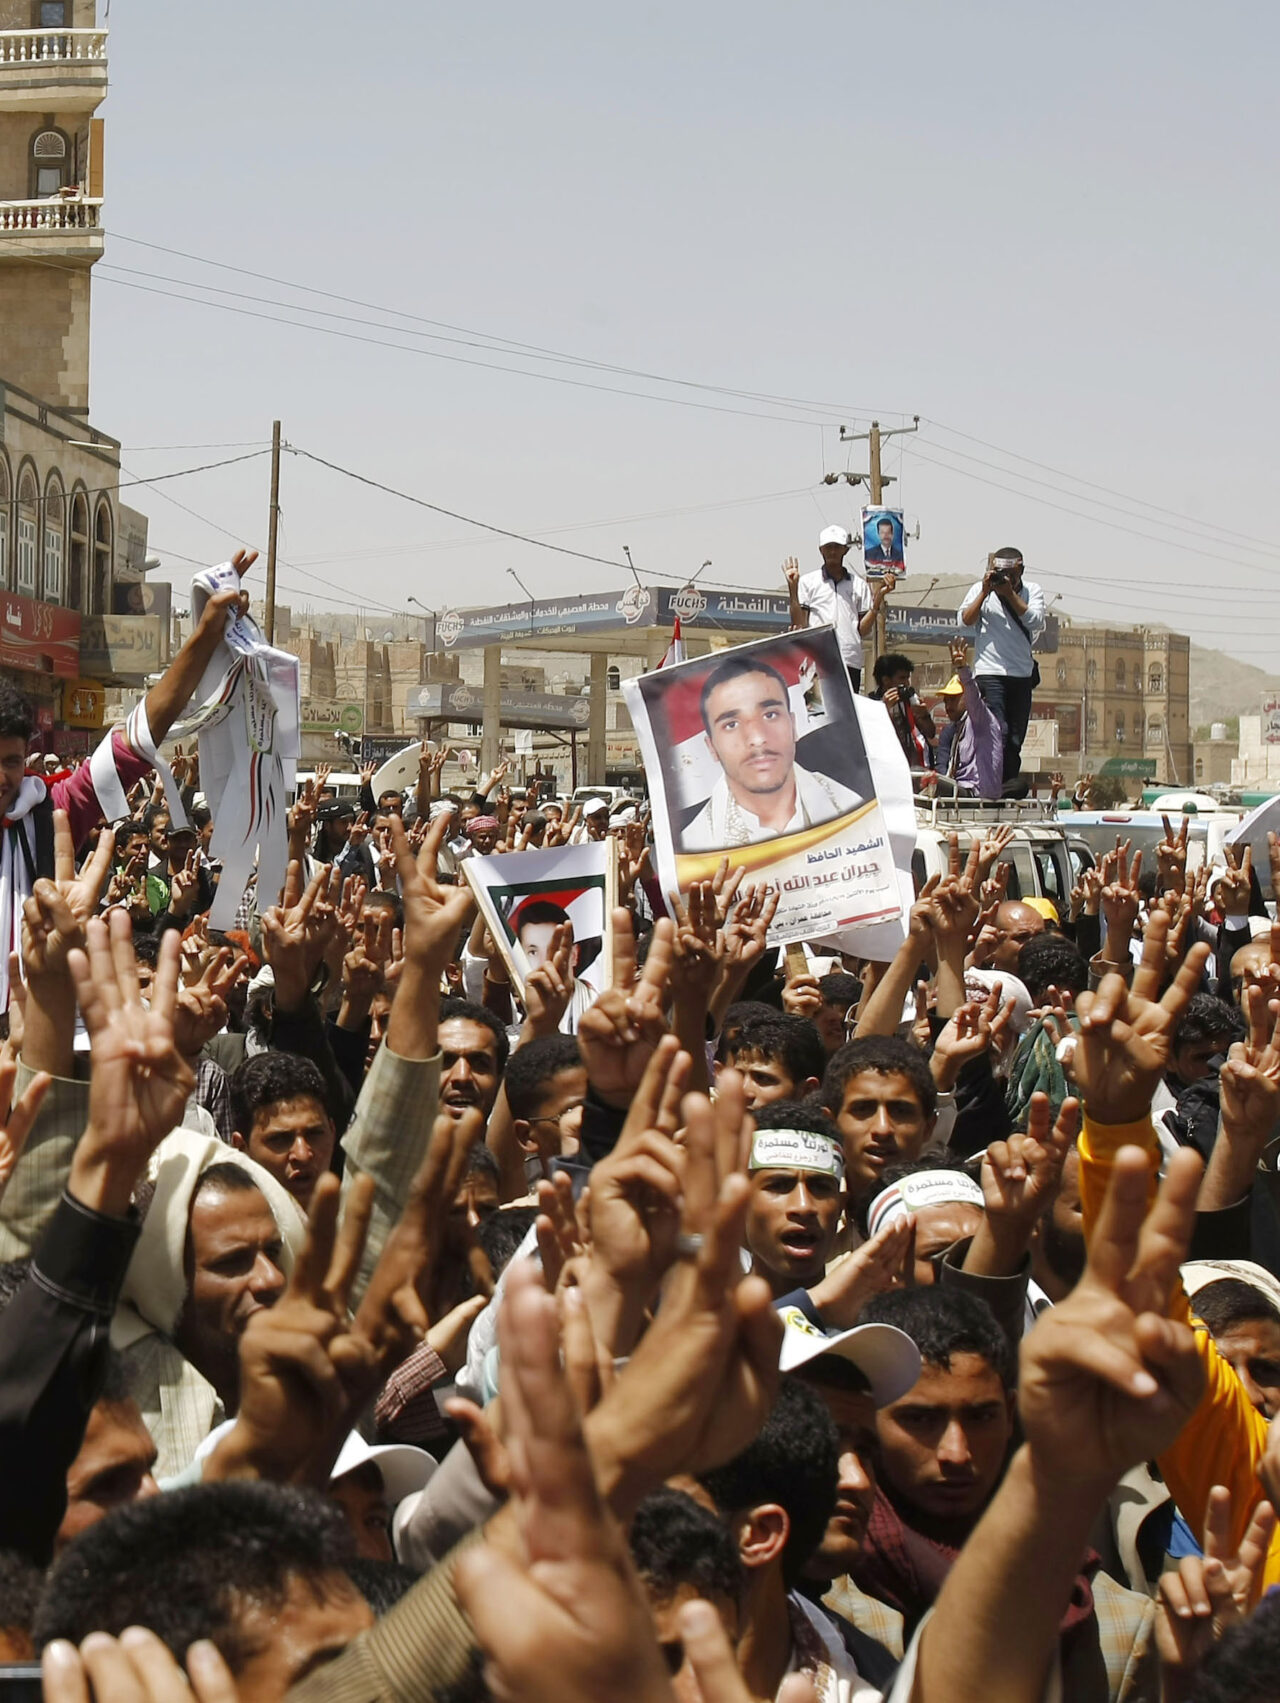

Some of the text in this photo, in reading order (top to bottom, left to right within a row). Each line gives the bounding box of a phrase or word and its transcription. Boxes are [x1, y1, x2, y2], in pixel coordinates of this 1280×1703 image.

[558, 603, 587, 616] العصيمي
[588, 602, 609, 612] محطة
[670, 596, 706, 609] FUCHS
[717, 596, 770, 615] النفطية
[531, 607, 557, 618] للخدمات
[436, 618, 464, 634] FUCHS
[470, 615, 494, 626] النفطية
[909, 615, 960, 631] عصيمي
[807, 837, 884, 864] الشهيد الحافظ
[812, 871, 839, 886] عبد
[841, 861, 881, 881] جبران
[783, 875, 810, 891] الله
[758, 1138, 829, 1153] ثورتنا مستمرة
[907, 1179, 954, 1194] مستمرة
